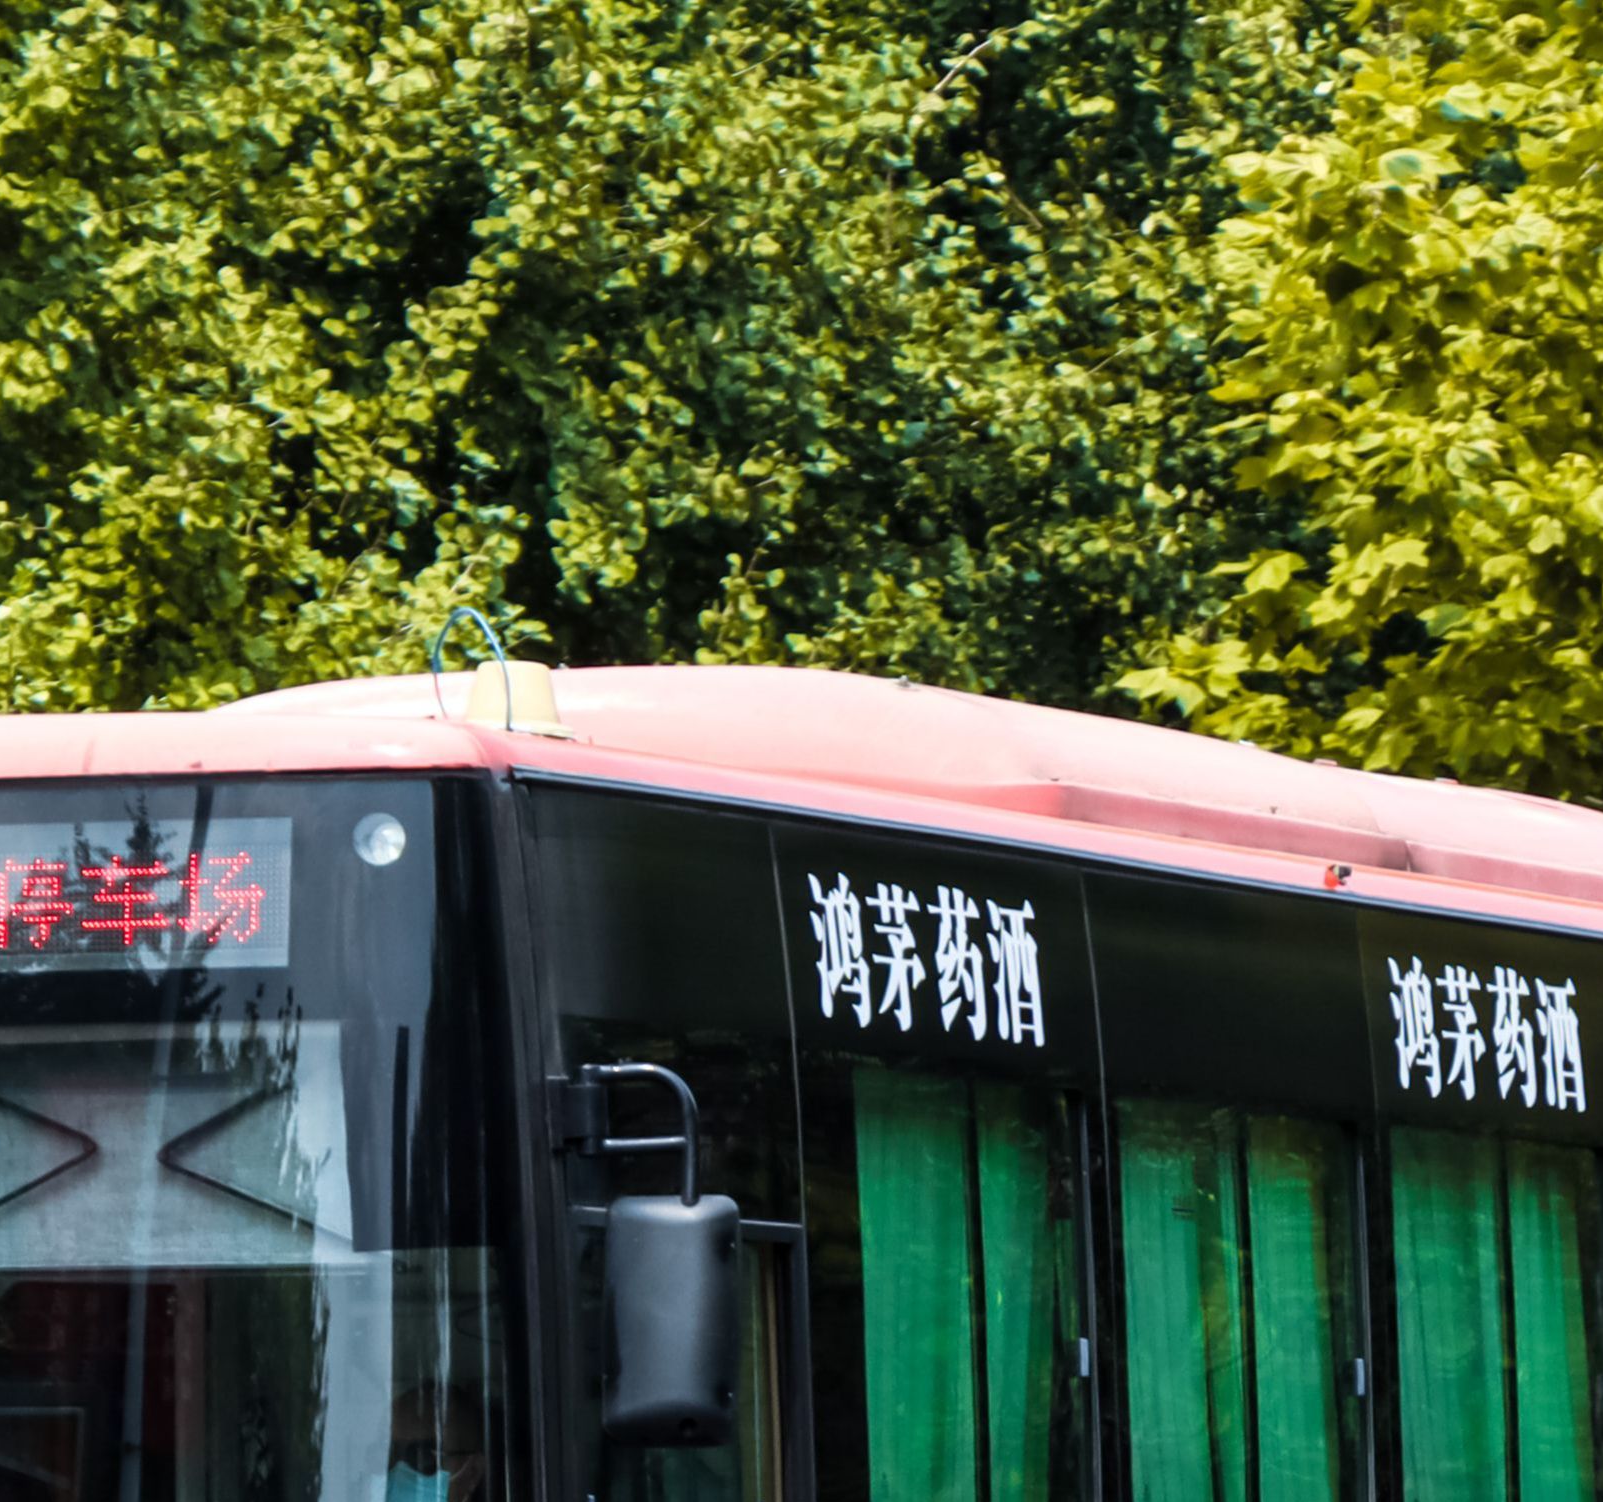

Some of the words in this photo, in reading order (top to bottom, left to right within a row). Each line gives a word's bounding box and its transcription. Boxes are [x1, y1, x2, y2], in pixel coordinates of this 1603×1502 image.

[807, 871, 1046, 1048] 鸿茅药酒
[1387, 956, 1587, 1113] 鸿茅药酒
